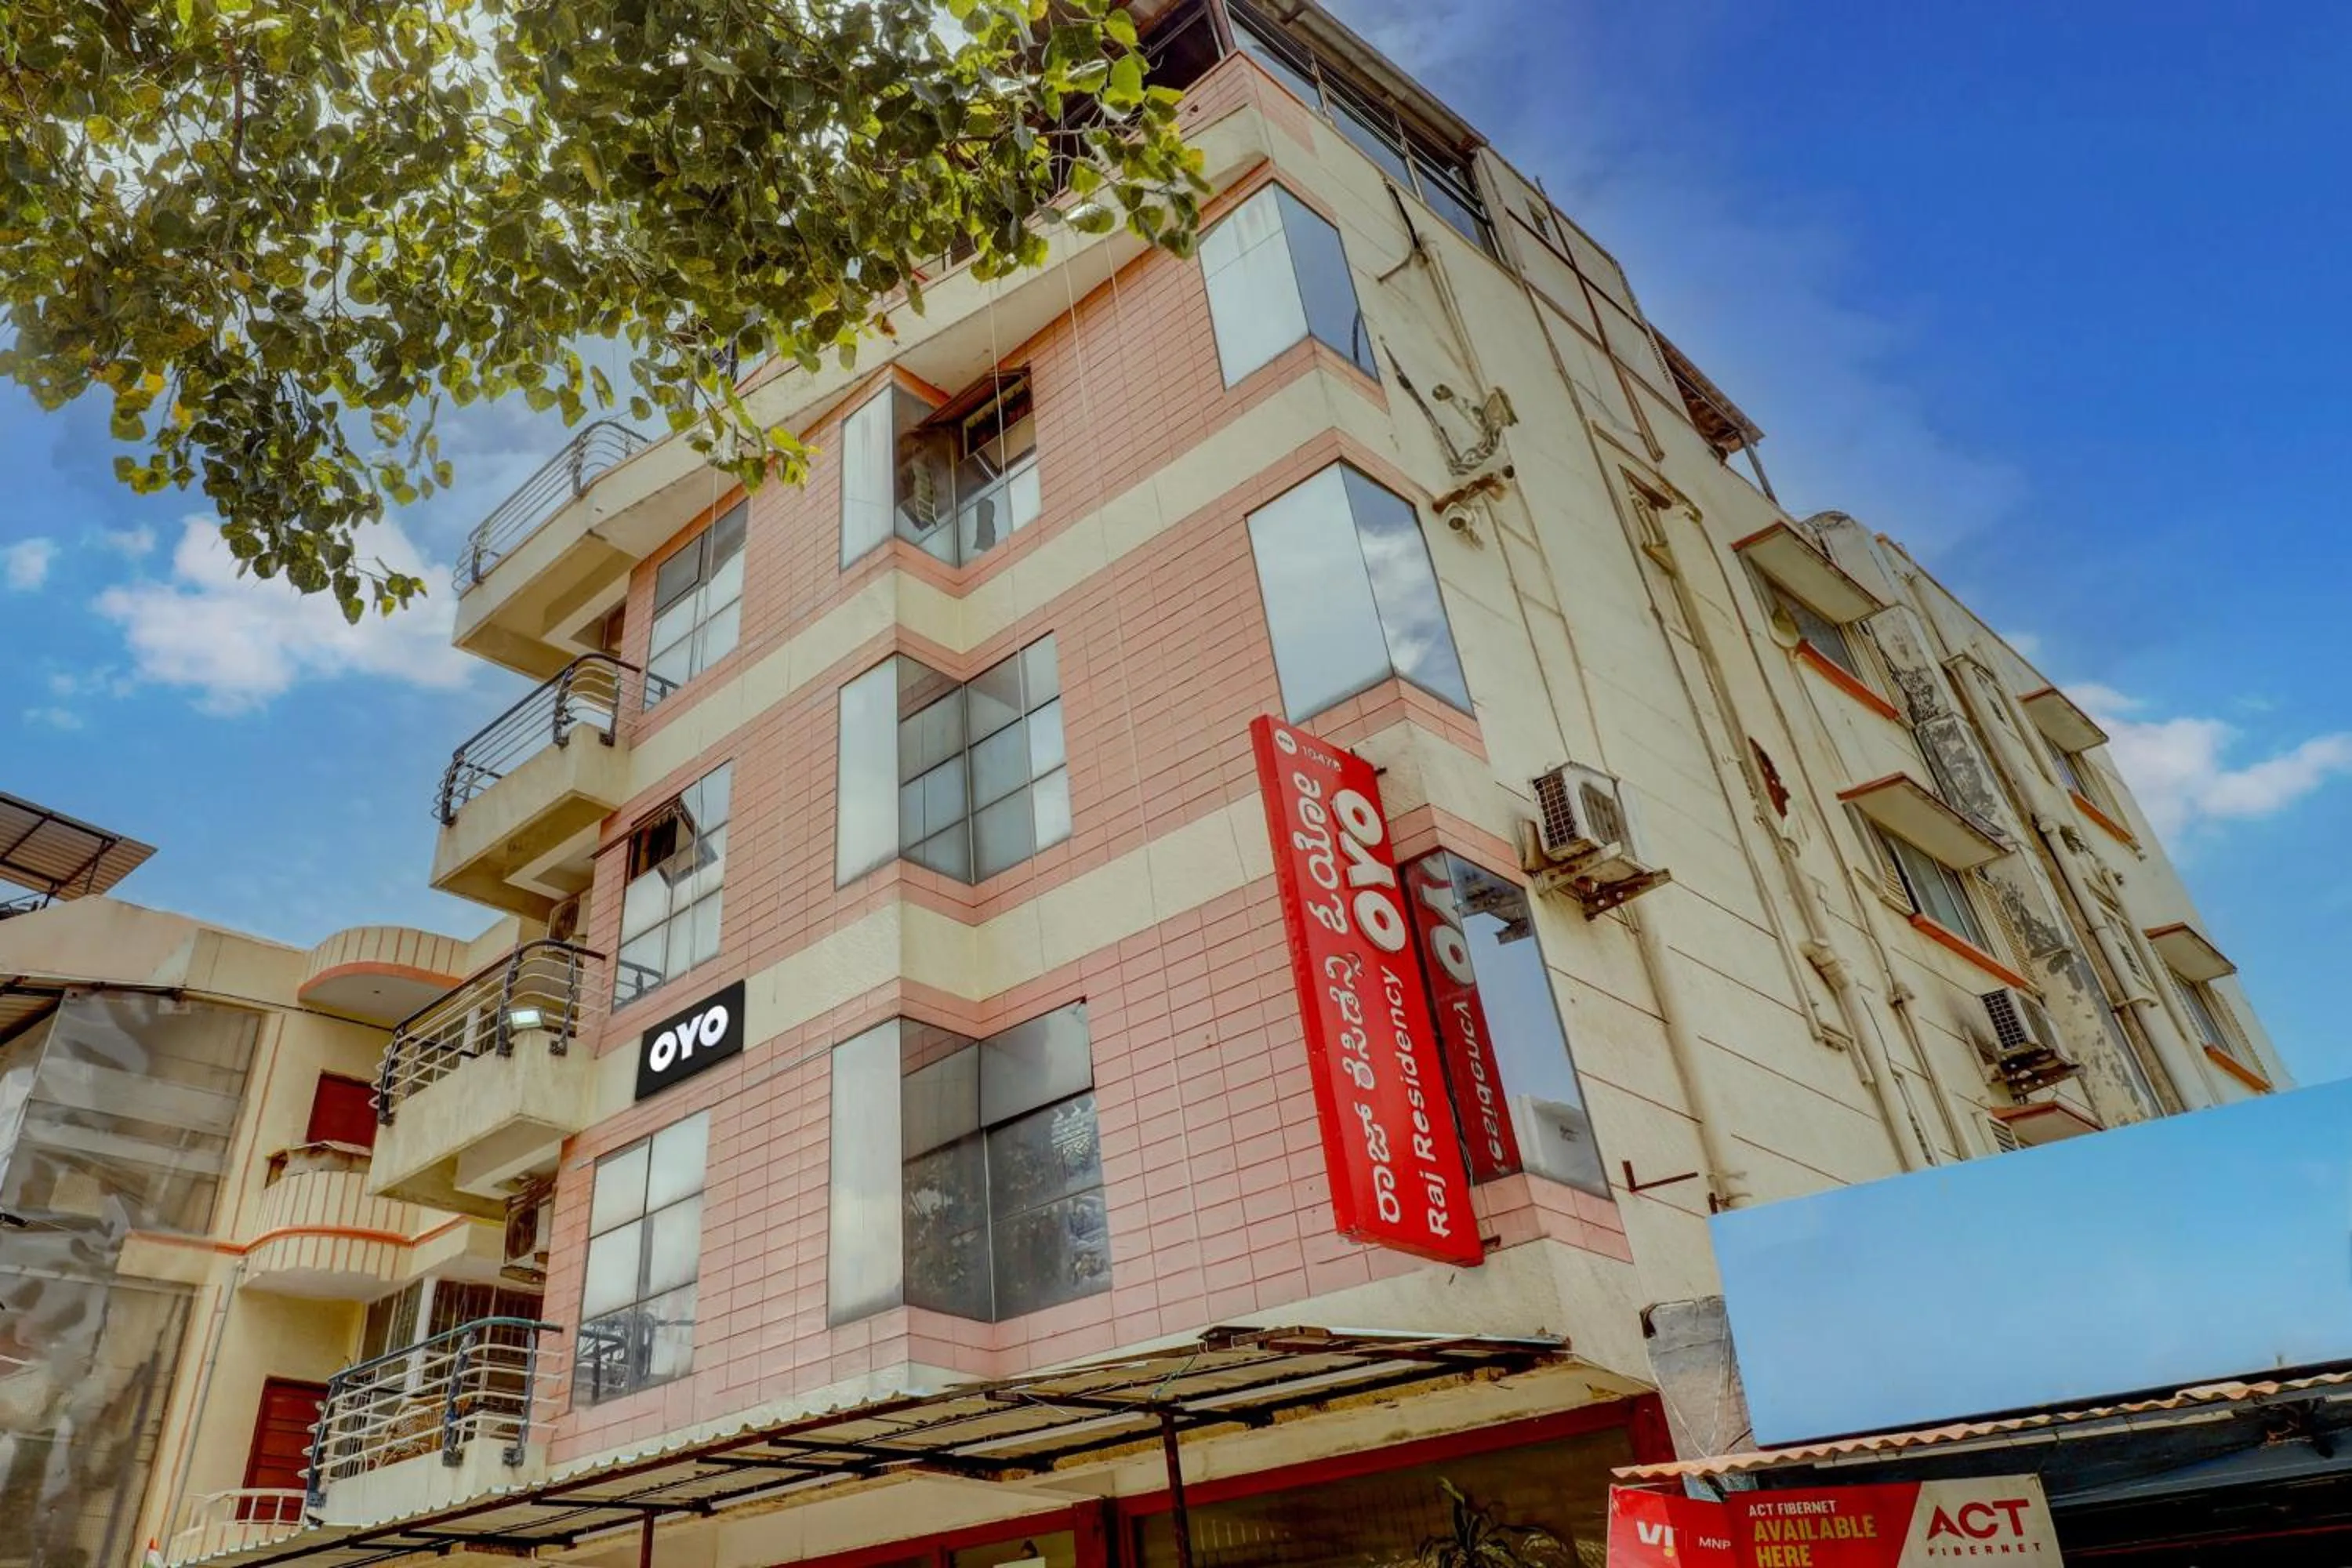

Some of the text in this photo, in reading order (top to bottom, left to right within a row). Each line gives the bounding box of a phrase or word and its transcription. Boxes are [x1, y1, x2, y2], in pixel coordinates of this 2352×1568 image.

[1330, 788, 1406, 953] OYO
[648, 1004, 729, 1073] OYO
[1380, 965, 1451, 1238] Raj Residency
[1749, 1499, 1837, 1517] ACT FIBERNET
[1926, 1498, 2031, 1541] ACT
[1699, 1536, 1732, 1550] MNP
[1753, 1513, 1878, 1543] AVAILABLE
[1755, 1544, 1814, 1568] HERE
[1927, 1541, 2042, 1556] FIBERNET
